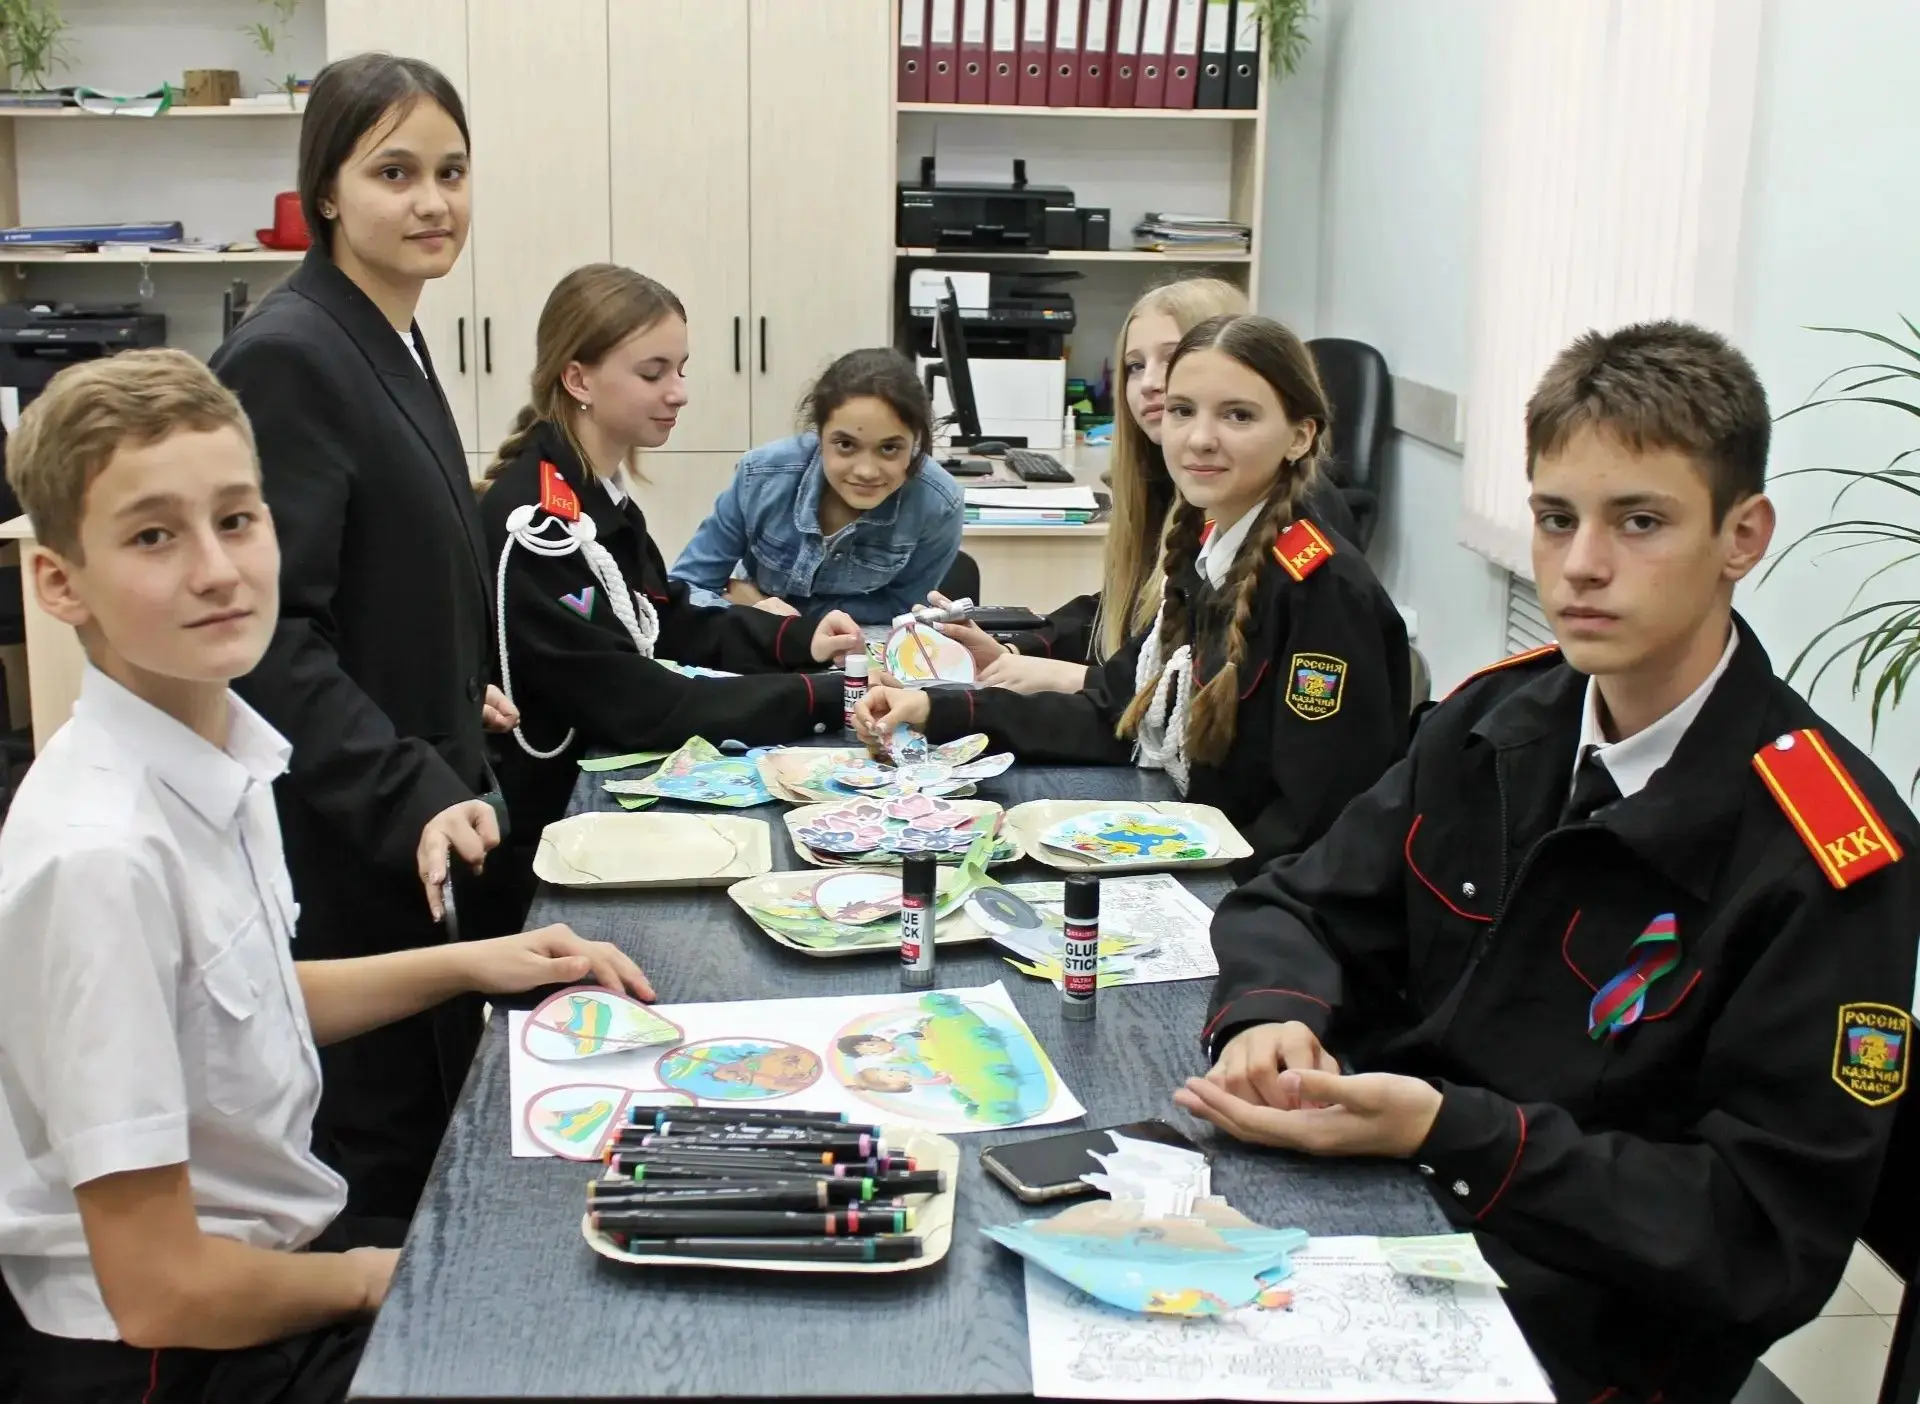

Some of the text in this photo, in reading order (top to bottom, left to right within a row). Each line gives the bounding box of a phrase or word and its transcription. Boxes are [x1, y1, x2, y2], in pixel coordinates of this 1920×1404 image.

[1290, 541, 1323, 569] КК
[1295, 657, 1343, 674] РОССИЯ
[1296, 702, 1327, 714] КЛАСС
[1825, 826, 1882, 868] КК
[1065, 942, 1098, 957] GLUE
[1845, 1011, 1906, 1031] РОССИЯ
[1850, 1078, 1891, 1094] КЛАСС
